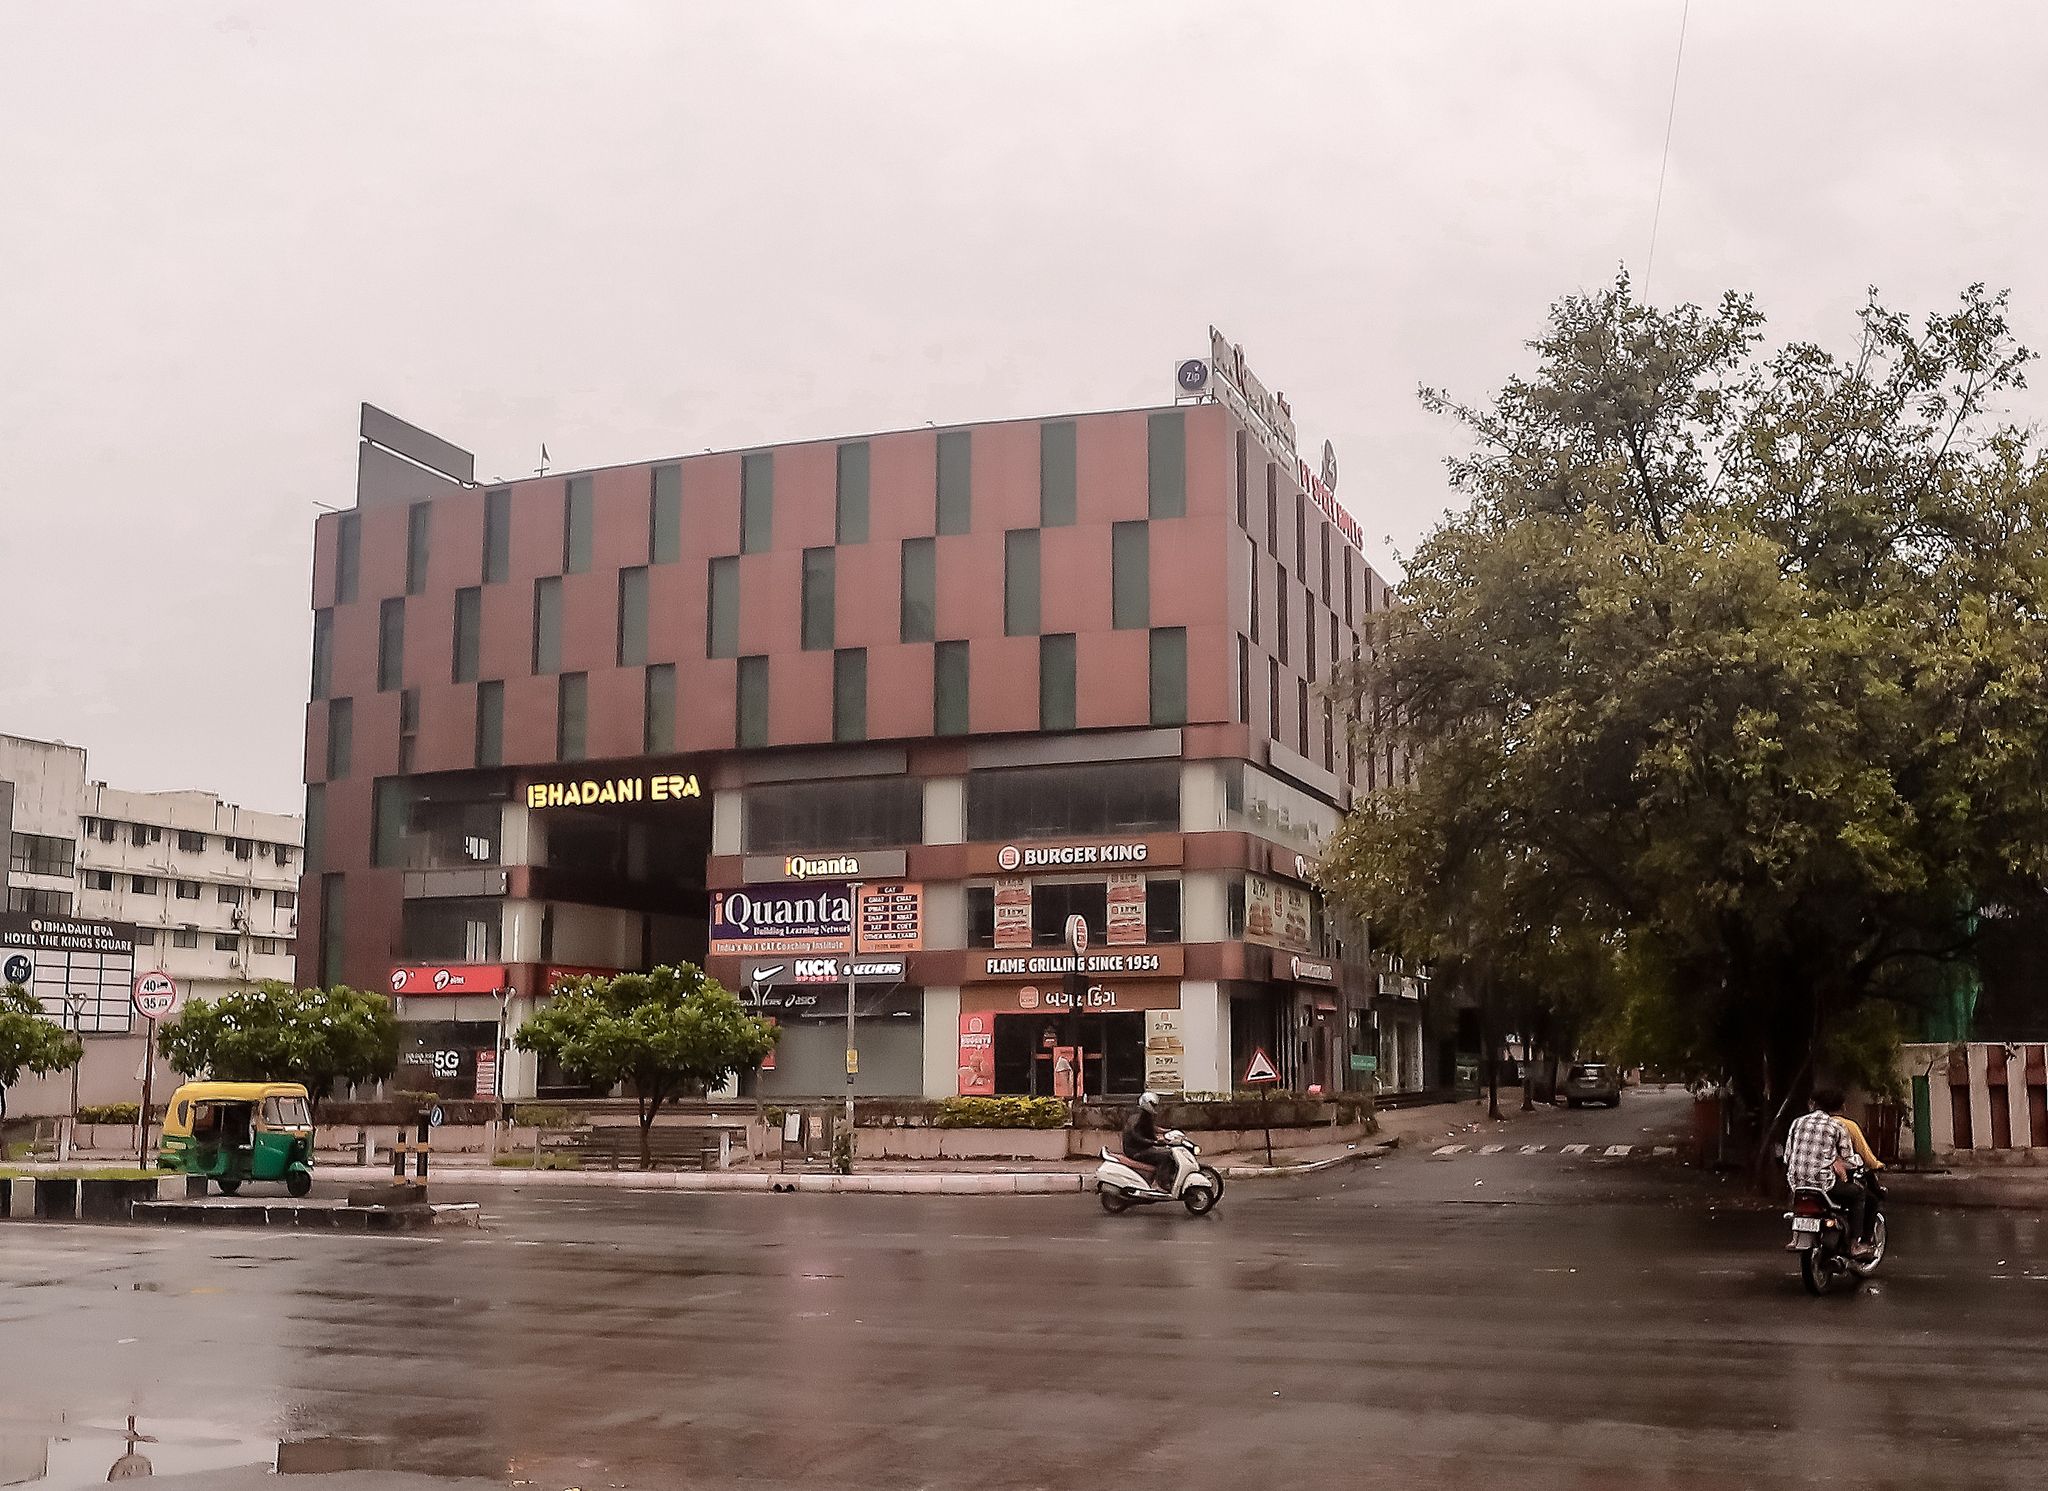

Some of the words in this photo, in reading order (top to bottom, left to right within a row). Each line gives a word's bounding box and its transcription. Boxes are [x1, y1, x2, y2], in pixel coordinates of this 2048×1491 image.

[527, 777, 644, 809] BHADANI
[650, 774, 701, 801] ERA
[1024, 849, 1097, 865] BURGER
[1100, 844, 1147, 862] KING
[785, 856, 859, 880] iQuanta
[714, 892, 851, 933] iQuanta
[4, 932, 37, 945] HOTEL
[40, 934, 59, 947] THE
[61, 937, 94, 949] KINGS
[95, 939, 133, 952] SQUARE
[794, 959, 837, 977] KICK
[986, 958, 1026, 974] FLAME
[1028, 956, 1085, 973] GRILLING
[1087, 956, 1124, 971] SINCE
[1126, 955, 1159, 970] 1954
[144, 980, 156, 992] 40
[144, 997, 156, 1009] 35
[434, 1050, 459, 1069] 5G
